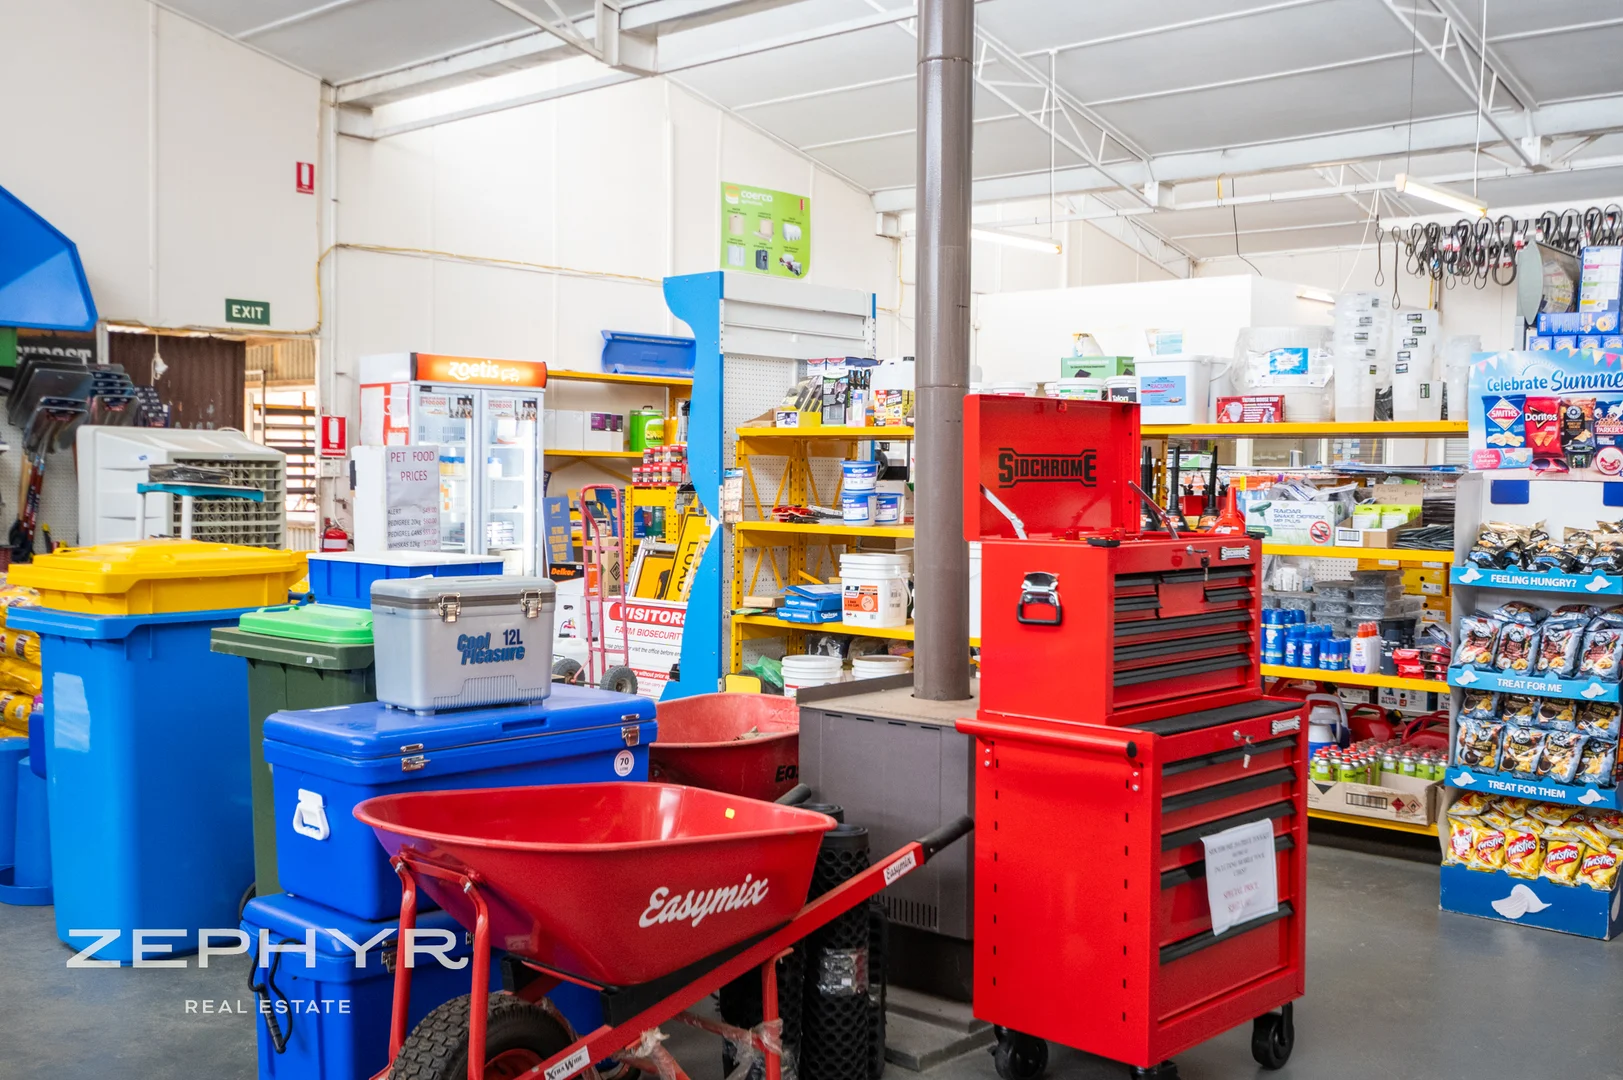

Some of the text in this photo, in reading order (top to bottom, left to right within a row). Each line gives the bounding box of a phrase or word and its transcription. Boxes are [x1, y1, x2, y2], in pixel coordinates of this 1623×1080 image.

[232, 304, 264, 319] EXIT
[448, 360, 500, 380] zoetis
[1488, 376, 1548, 392] Celebrate
[1524, 412, 1558, 422] Doritos
[390, 451, 435, 462] PET FOOD
[998, 453, 1096, 482] SIDCHROME
[400, 470, 428, 481] PRICES
[551, 567, 576, 576] Delkor
[677, 542, 700, 592] LOAD
[1491, 574, 1577, 588] FEELING HUNGRY?
[457, 629, 523, 652] Cool 12L
[615, 626, 681, 640] FAM BIOSECURIT
[461, 646, 525, 665] Pleasure
[1497, 678, 1562, 692] TREAT FOR ME
[620, 758, 629, 766] 70
[1488, 780, 1566, 798] TREAT FOR THEM
[1507, 838, 1536, 857] Twisties
[1546, 849, 1578, 863] Twisties
[1583, 854, 1616, 869] Twisties
[885, 855, 914, 881] Easymix
[638, 873, 770, 928] Easymix
[565, 1055, 582, 1071] WIDE
